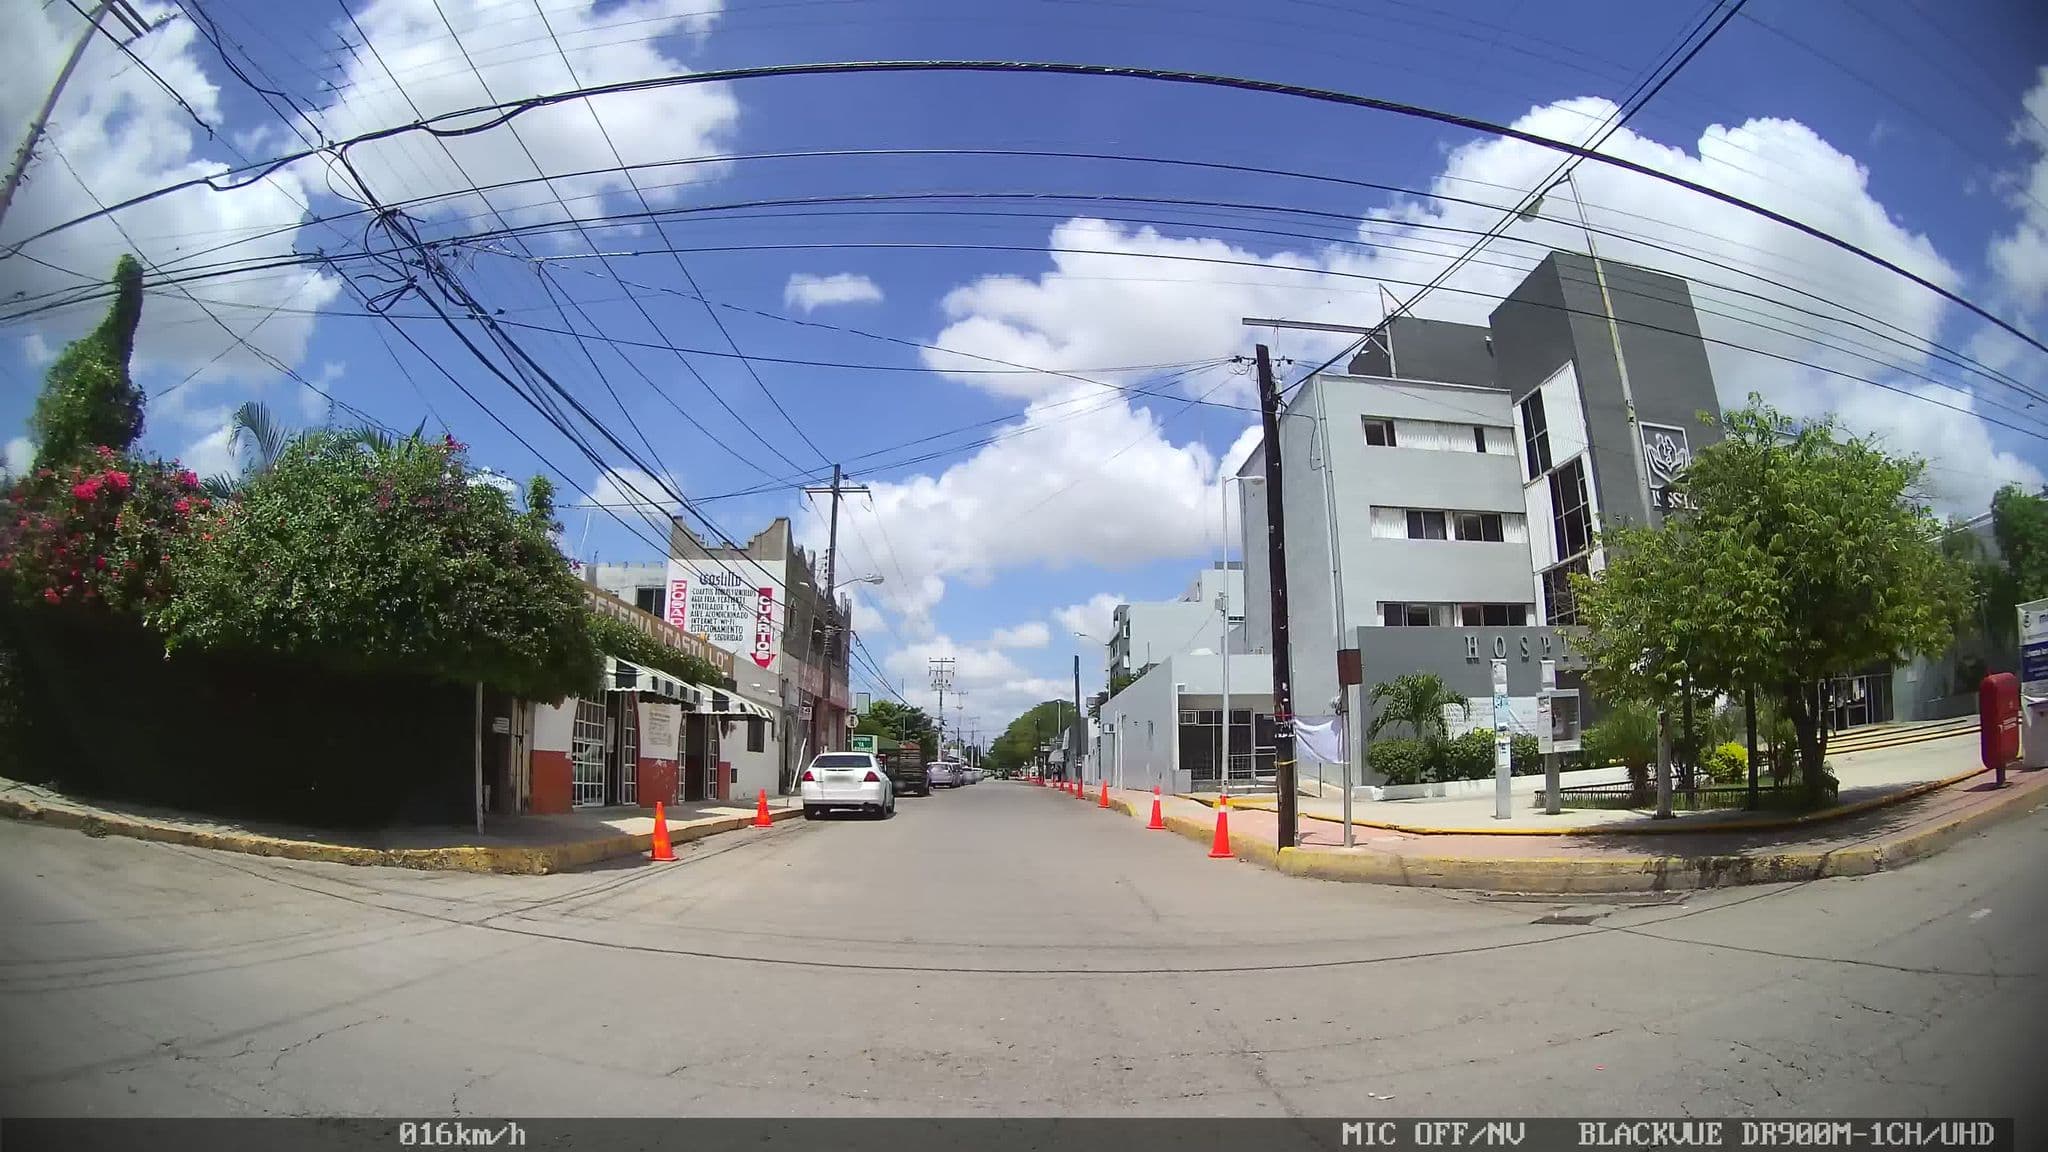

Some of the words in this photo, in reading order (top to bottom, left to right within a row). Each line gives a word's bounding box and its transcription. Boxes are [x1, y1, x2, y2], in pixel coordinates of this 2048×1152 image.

[670, 581, 688, 628] POSAD
[691, 603, 724, 611] VENTILADOR
[690, 617, 717, 625] INTERNET
[690, 624, 744, 634] ESTACIONAMIENTO
[756, 595, 772, 661] CUARTOS
[714, 633, 744, 641] SEGURIDAD
[1464, 634, 1570, 660] HOSPI
